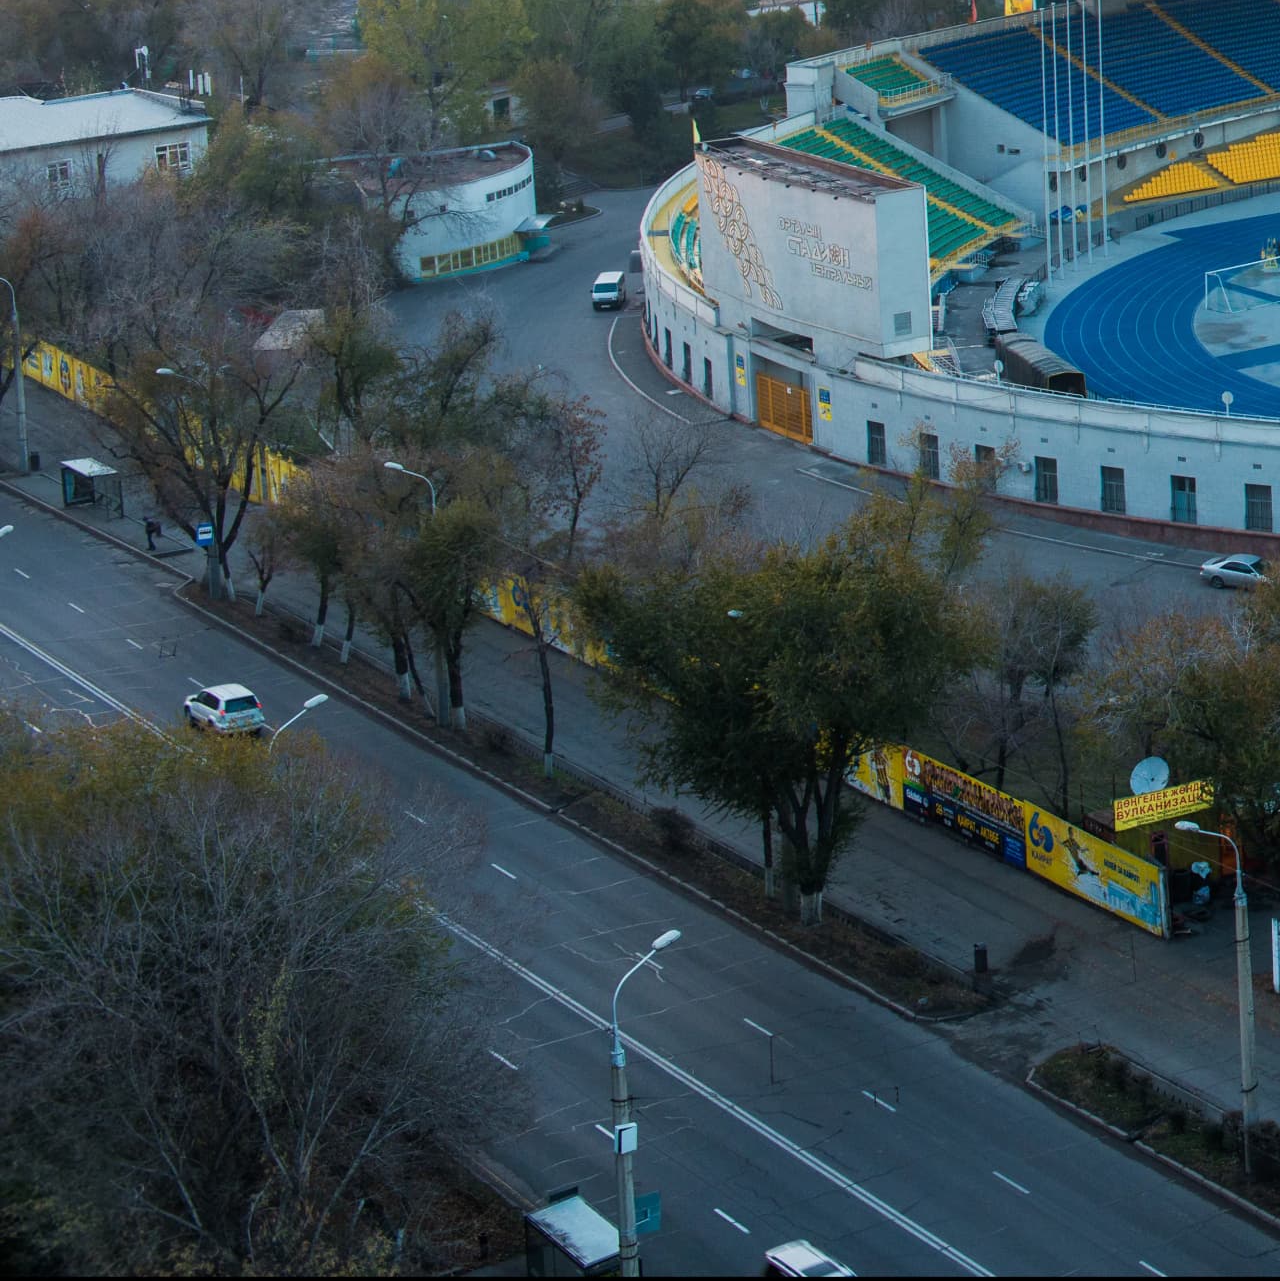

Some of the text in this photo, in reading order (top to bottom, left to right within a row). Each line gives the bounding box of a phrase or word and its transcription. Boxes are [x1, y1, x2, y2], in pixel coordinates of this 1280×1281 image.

[787, 235, 850, 269] СТАДИОН
[1170, 780, 1211, 797] ЖӨНД
[1116, 792, 1208, 821] ВУЛКАНИЗАЦ
[1028, 810, 1054, 854] 60
